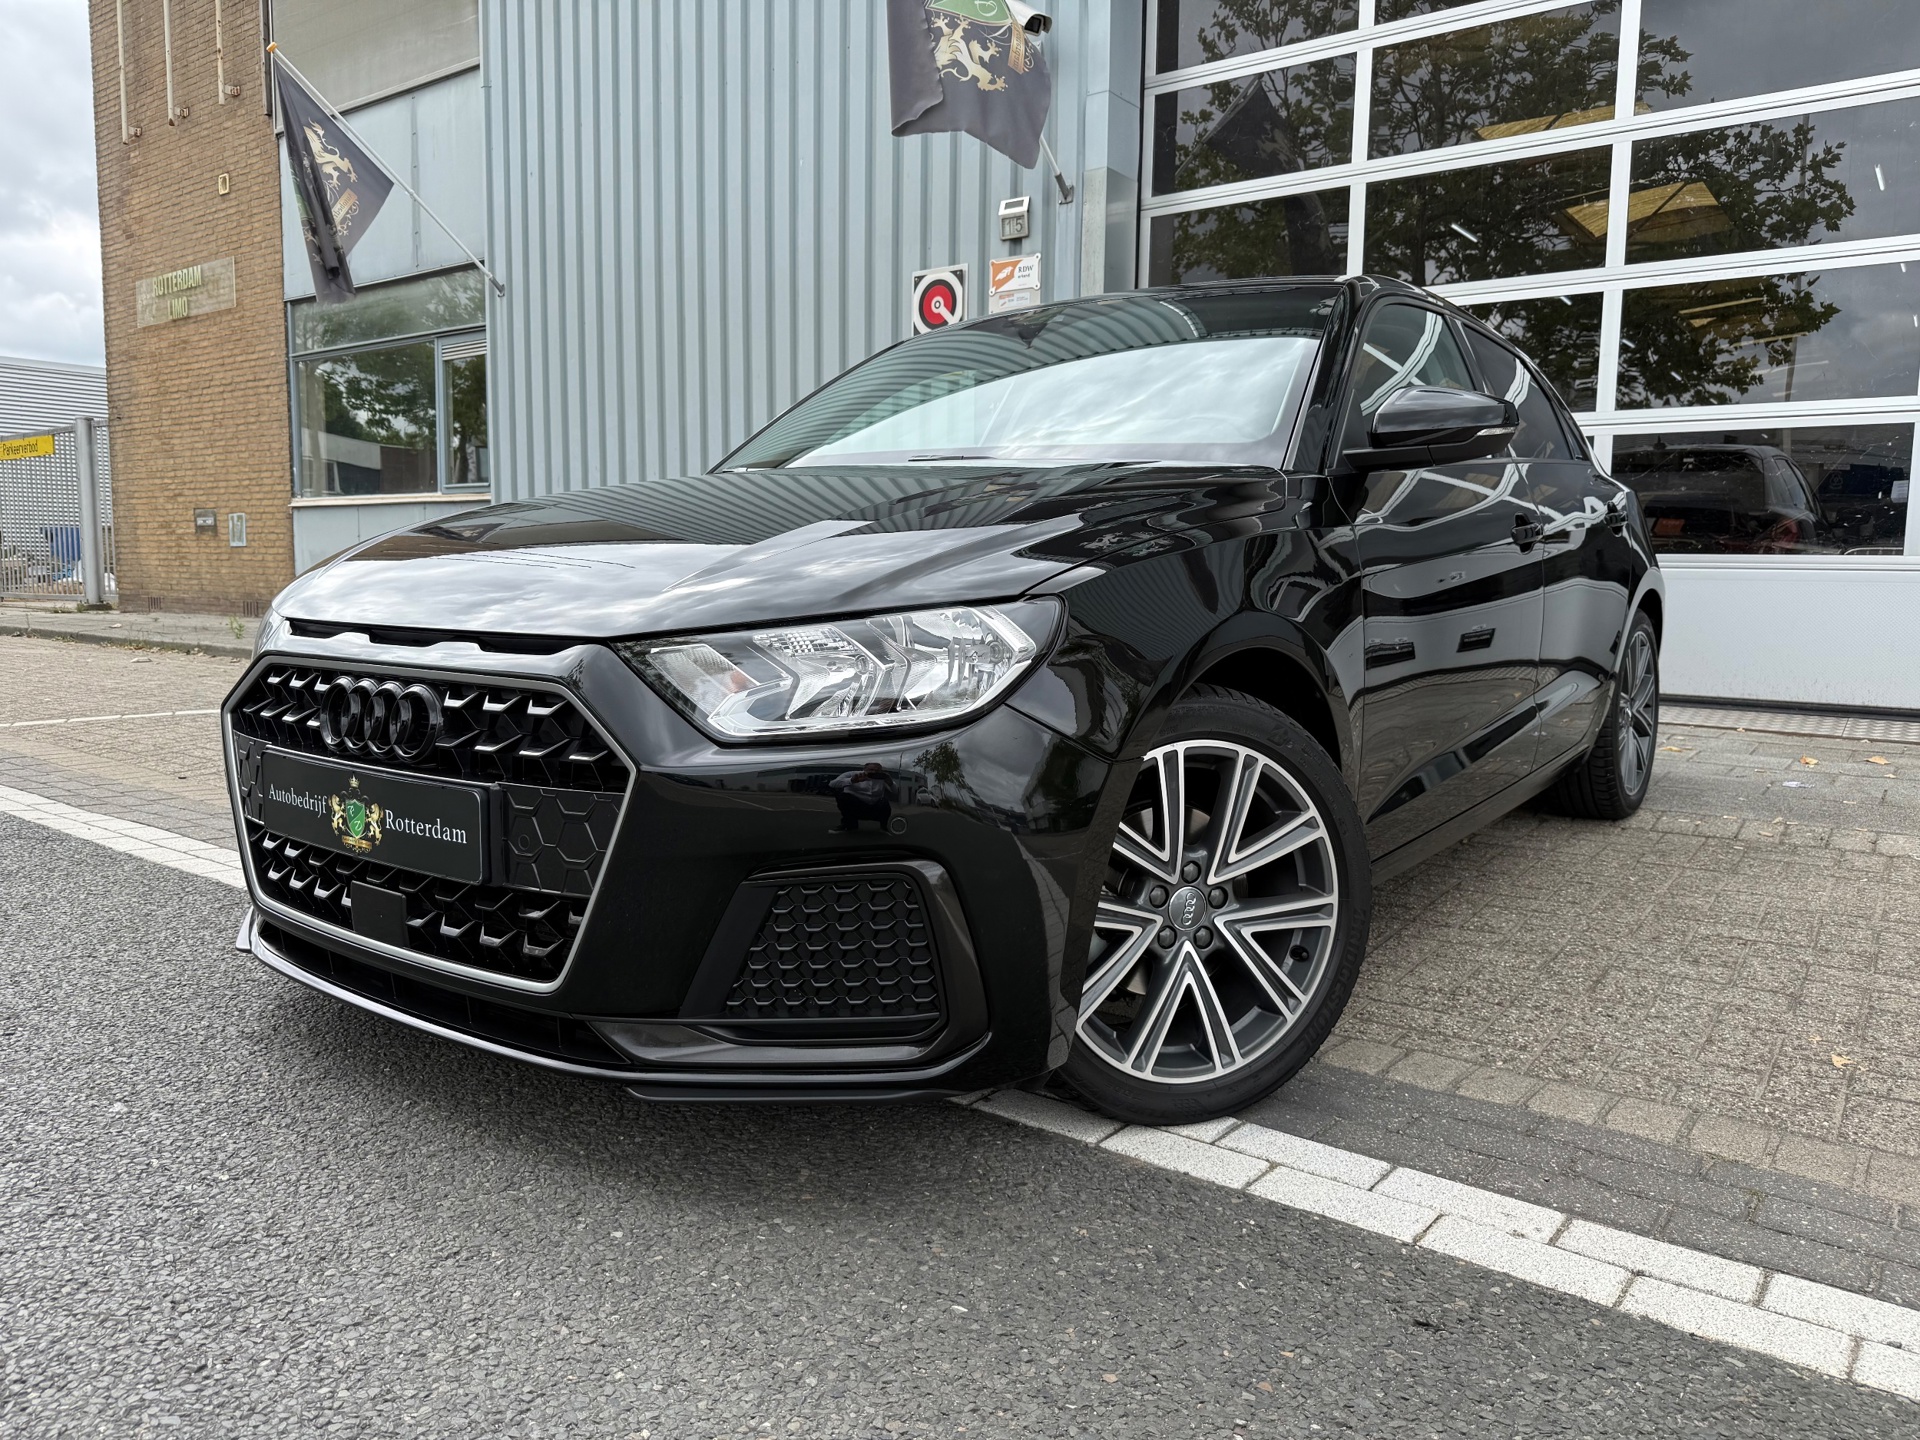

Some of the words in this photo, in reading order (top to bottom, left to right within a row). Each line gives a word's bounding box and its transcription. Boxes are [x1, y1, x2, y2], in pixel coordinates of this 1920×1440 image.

[1006, 217, 1023, 235] 15
[152, 264, 201, 297] ROTTERDAM
[1017, 264, 1034, 273] RDW
[2, 439, 38, 456] Parkeerverbod
[268, 783, 328, 818] Autobedrijf
[384, 809, 468, 844] Rotterdam
